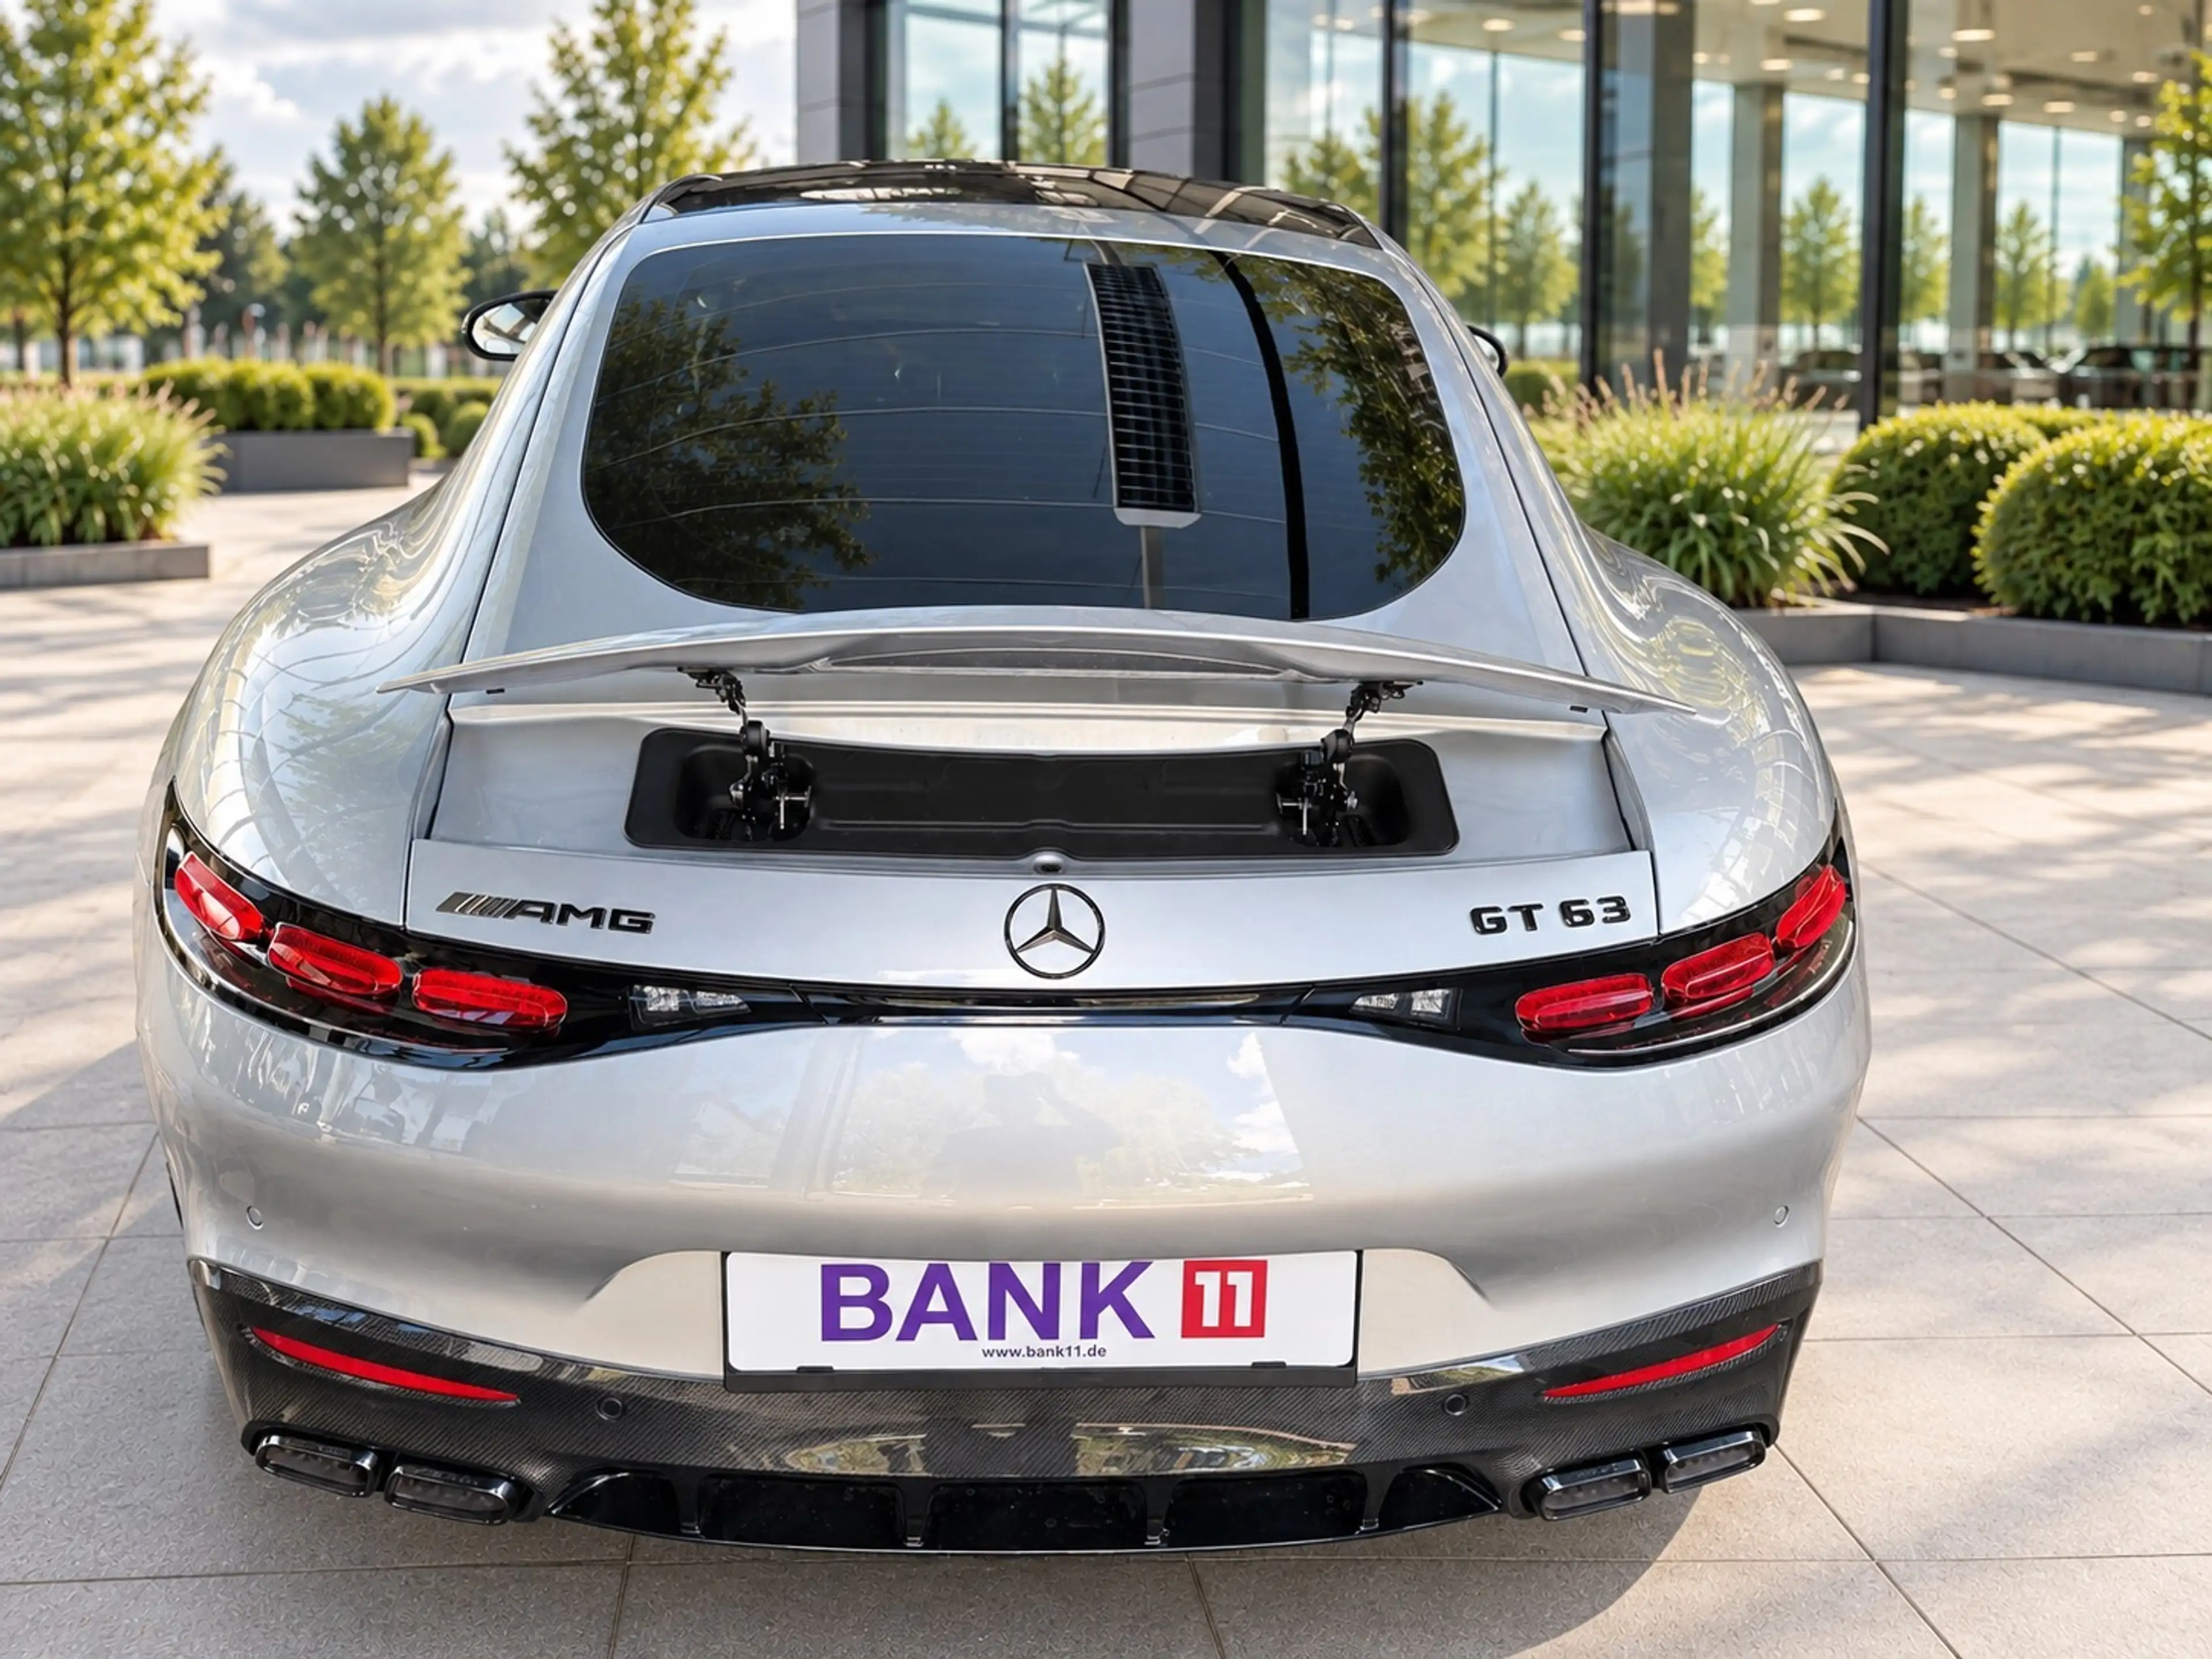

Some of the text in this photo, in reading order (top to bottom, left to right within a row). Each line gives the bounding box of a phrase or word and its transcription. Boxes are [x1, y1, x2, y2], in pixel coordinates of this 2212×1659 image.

[502, 899, 656, 934] AMG
[1469, 895, 1631, 935] GT 63
[821, 1262, 1254, 1342] BANK 11
[982, 1344, 1107, 1358] www.bank11.de
